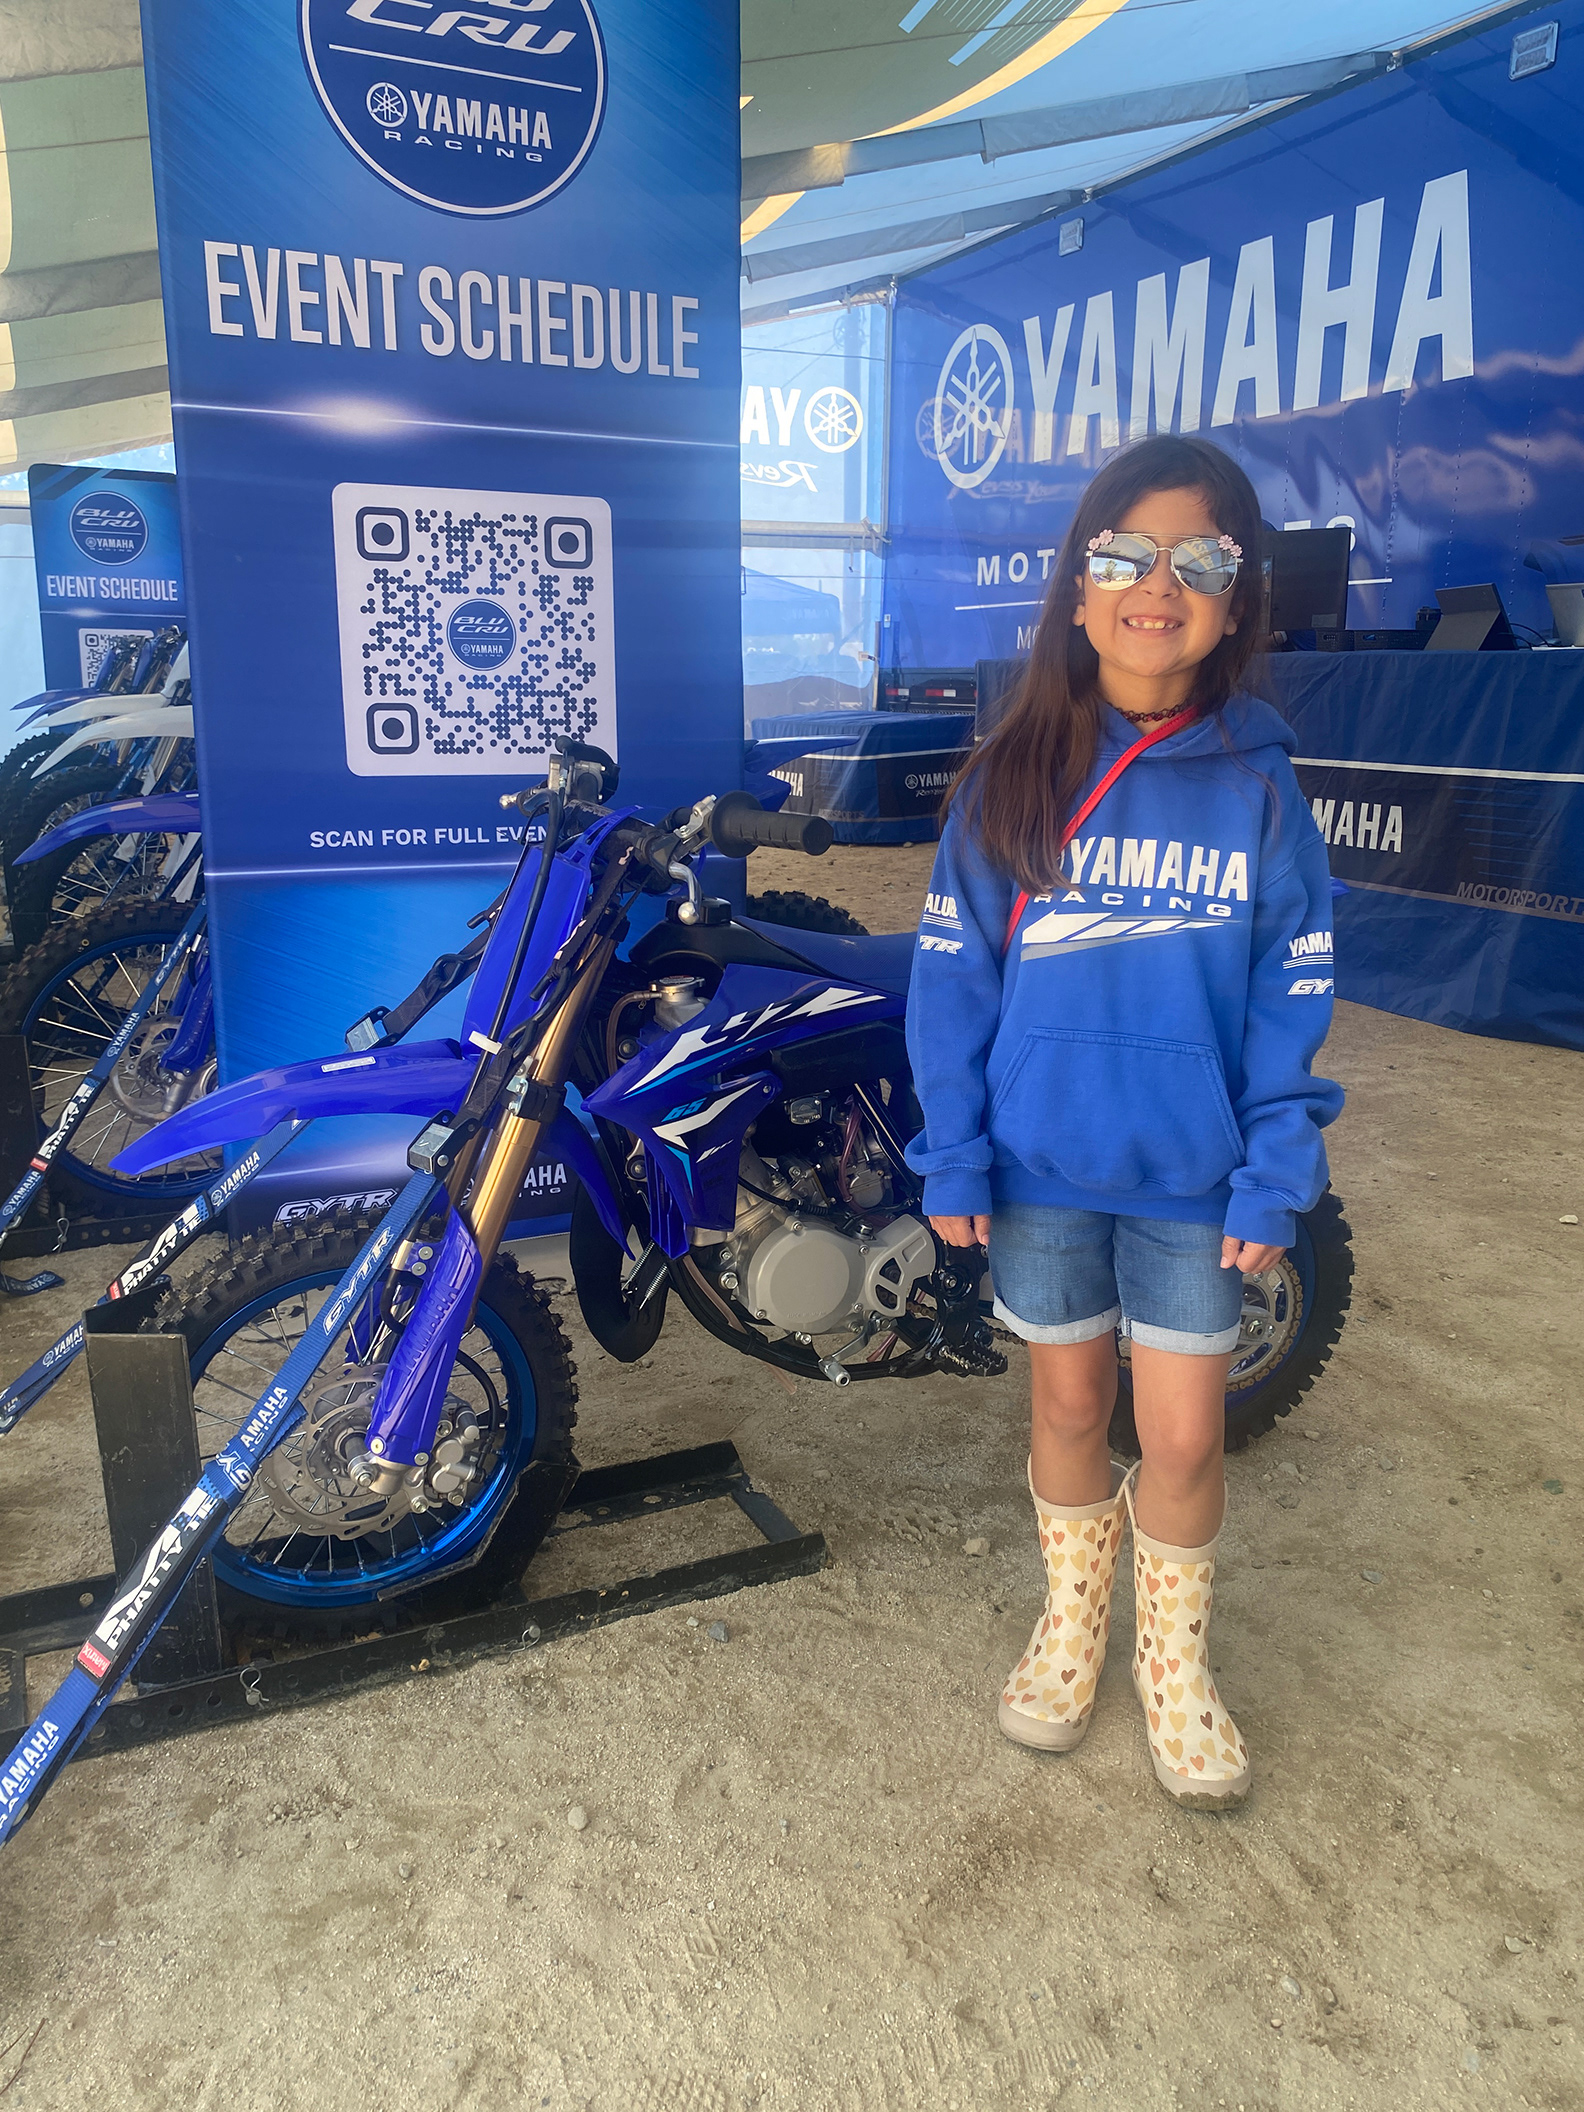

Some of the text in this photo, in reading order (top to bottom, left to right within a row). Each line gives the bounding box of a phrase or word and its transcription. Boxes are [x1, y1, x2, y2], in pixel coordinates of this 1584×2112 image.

[346, 0, 577, 54] CRU
[409, 89, 552, 150] YAMAHA
[384, 130, 543, 163] RACING
[204, 240, 699, 379] EVENT SCHEDULE
[1023, 169, 1474, 463] YAMAHA
[76, 508, 135, 518] BLU
[80, 517, 140, 528] CRU
[97, 538, 134, 549] YAMAHA
[46, 575, 178, 601] EVENT SCHEDULE
[453, 616, 505, 625] BLU
[457, 625, 509, 633] CRU
[470, 644, 504, 654] YAMAHA
[919, 771, 958, 787] YAMAH
[310, 825, 548, 848] SCAN FOR FULL EVEN
[1070, 836, 1248, 901] YAMAHA
[1033, 890, 1232, 918] RACING
[1456, 882, 1584, 917] MOTORSPORT
[112, 1012, 140, 1046] YAMAHA
[661, 1097, 707, 1122] 65
[8, 1170, 40, 1205] YAMAHA
[220, 1151, 261, 1195] YAMAHA
[275, 1188, 398, 1228] GYTR
[124, 1235, 178, 1296] PHATTY
[179, 1213, 203, 1238] TIE
[322, 1226, 394, 1336] GYTR
[54, 1325, 84, 1356] YAMAH
[240, 1386, 287, 1448] AMAHA
[106, 1494, 219, 1651] PHATTY TIE
